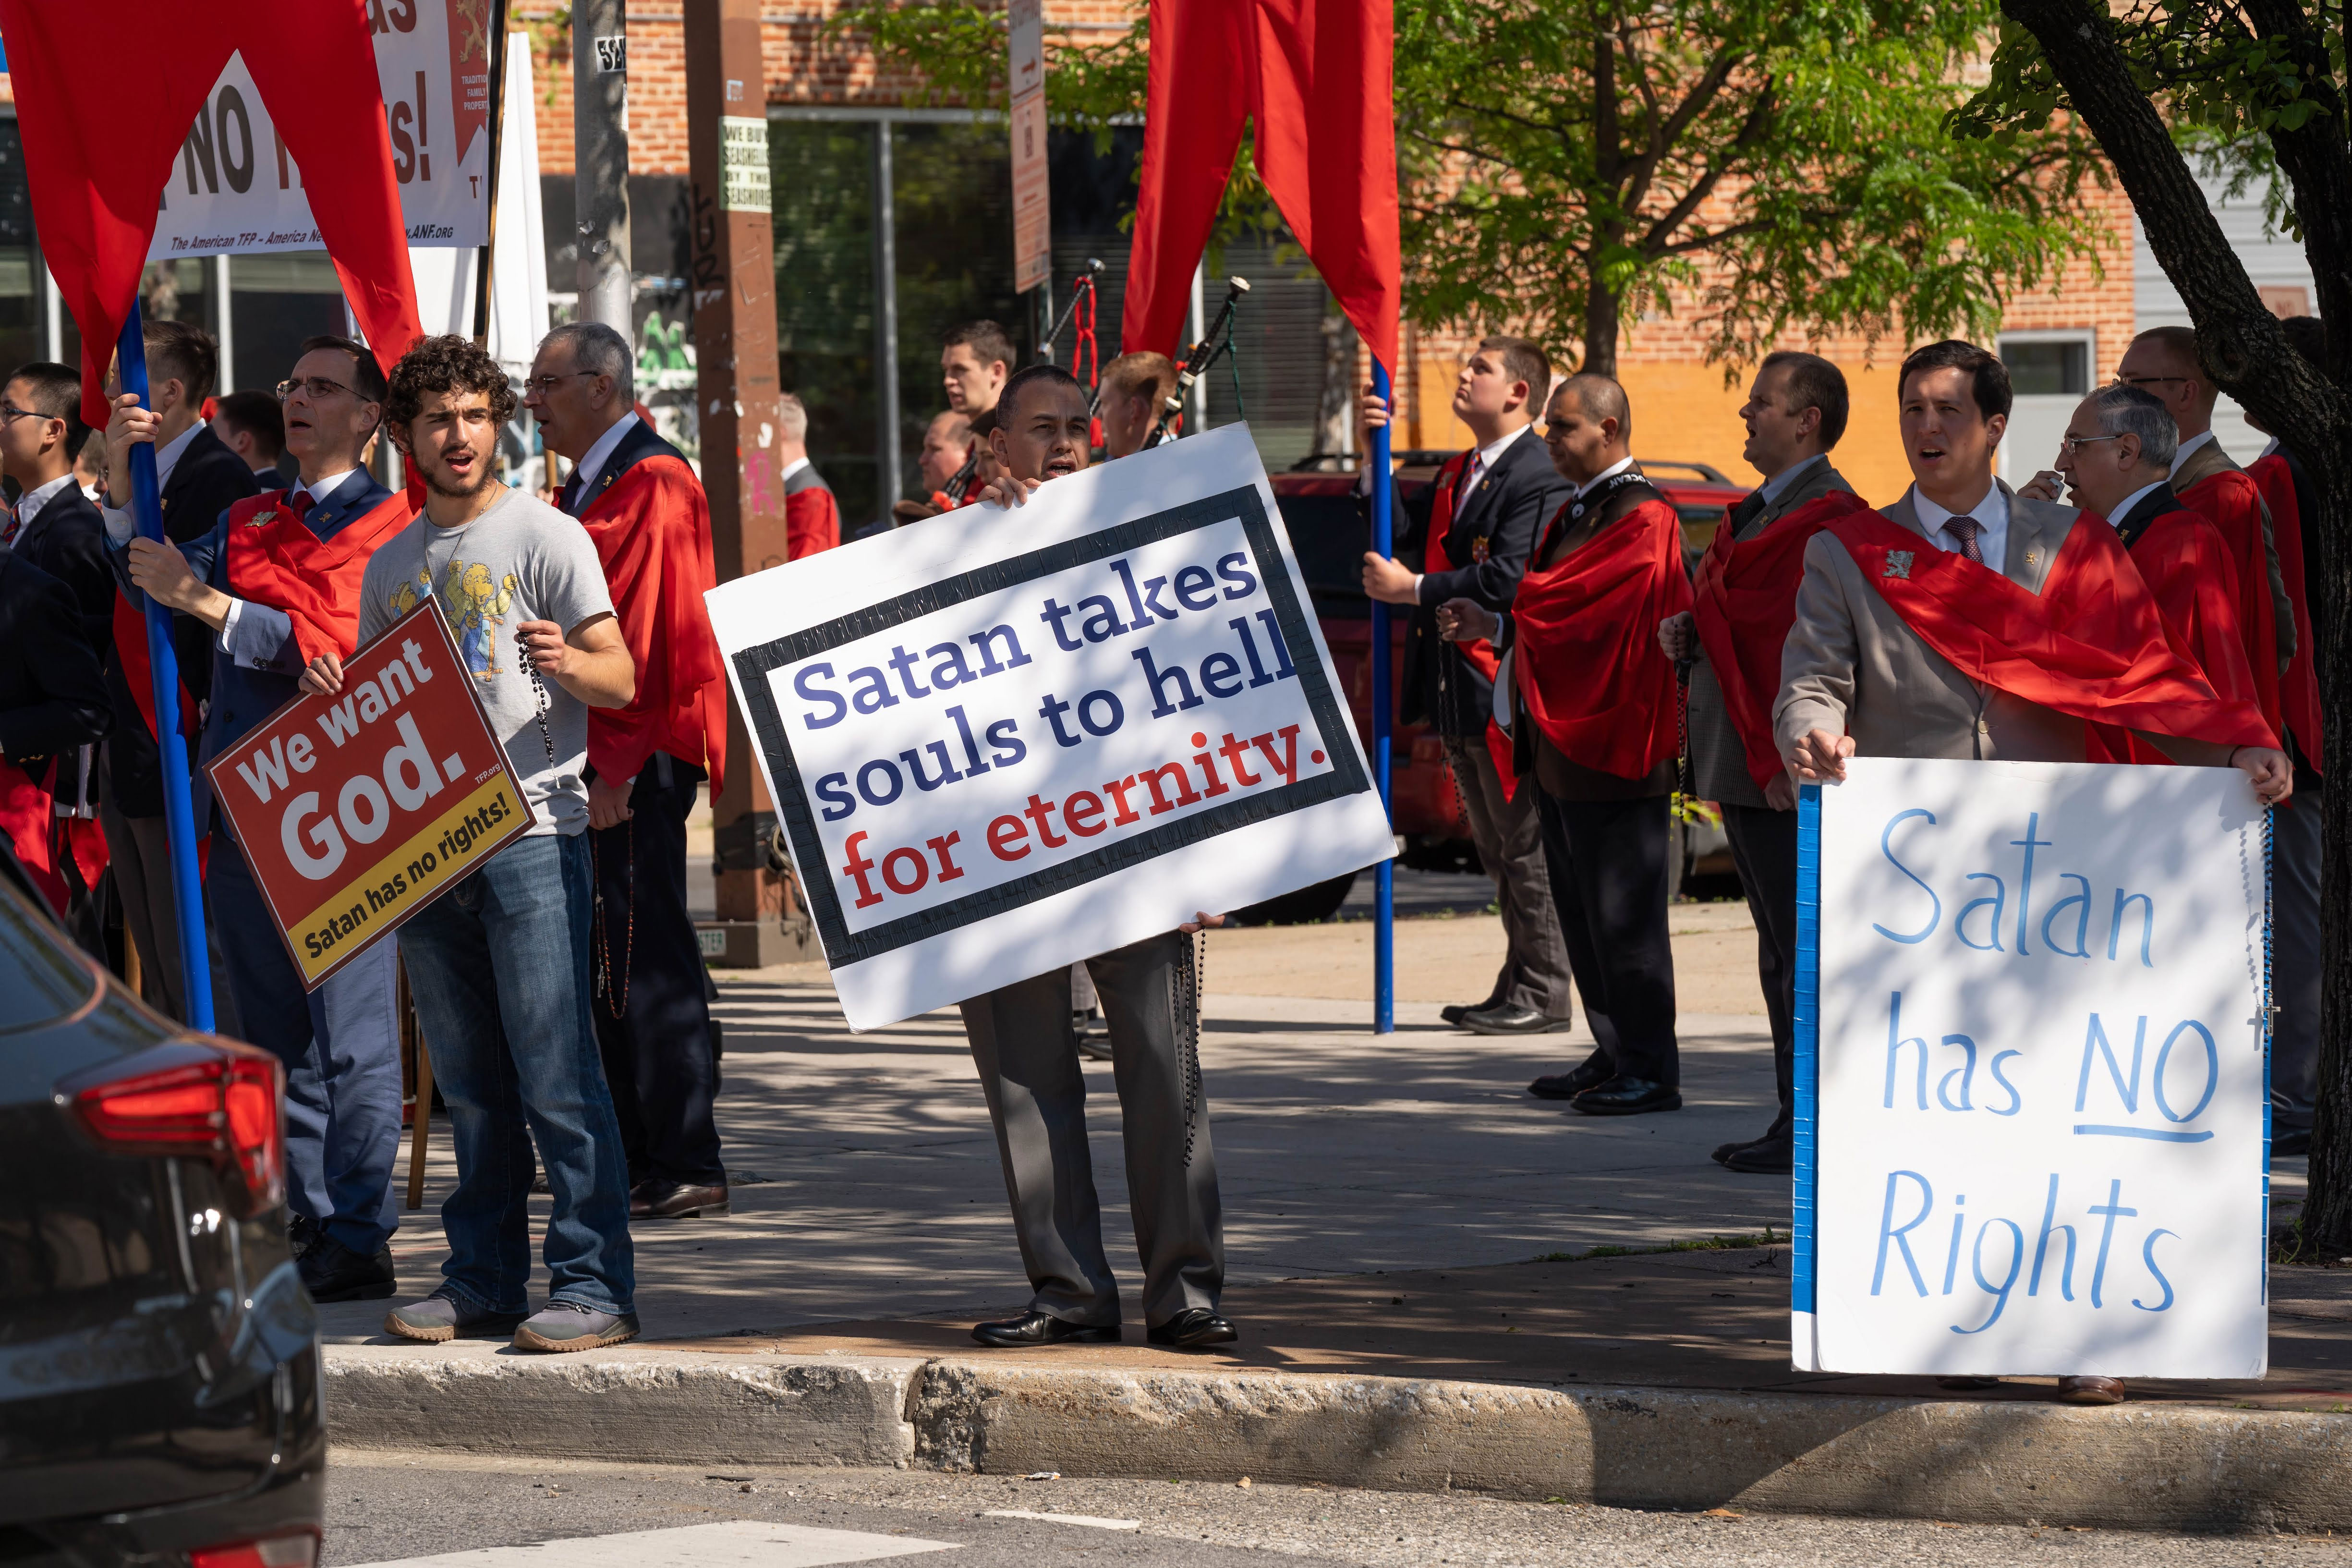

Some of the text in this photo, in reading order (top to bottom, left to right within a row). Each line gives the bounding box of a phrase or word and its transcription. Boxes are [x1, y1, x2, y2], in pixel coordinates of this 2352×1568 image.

[182, 85, 254, 194] NO
[467, 88, 486, 97] FAMILY
[171, 237, 189, 250] The
[189, 234, 235, 249] American
[237, 232, 257, 246] TFP
[265, 230, 307, 244] America
[236, 638, 433, 804] We want
[794, 552, 1257, 730] Satan takes
[815, 608, 1298, 822] souls to hell
[280, 711, 466, 880] God.
[474, 763, 501, 784] TFP.org
[843, 724, 1325, 909] for eternity.
[304, 792, 511, 959] Satan has no rights!
[1873, 808, 2154, 967] Satan
[1884, 991, 2219, 1123] has NO
[1871, 1170, 2182, 1334] Rights
